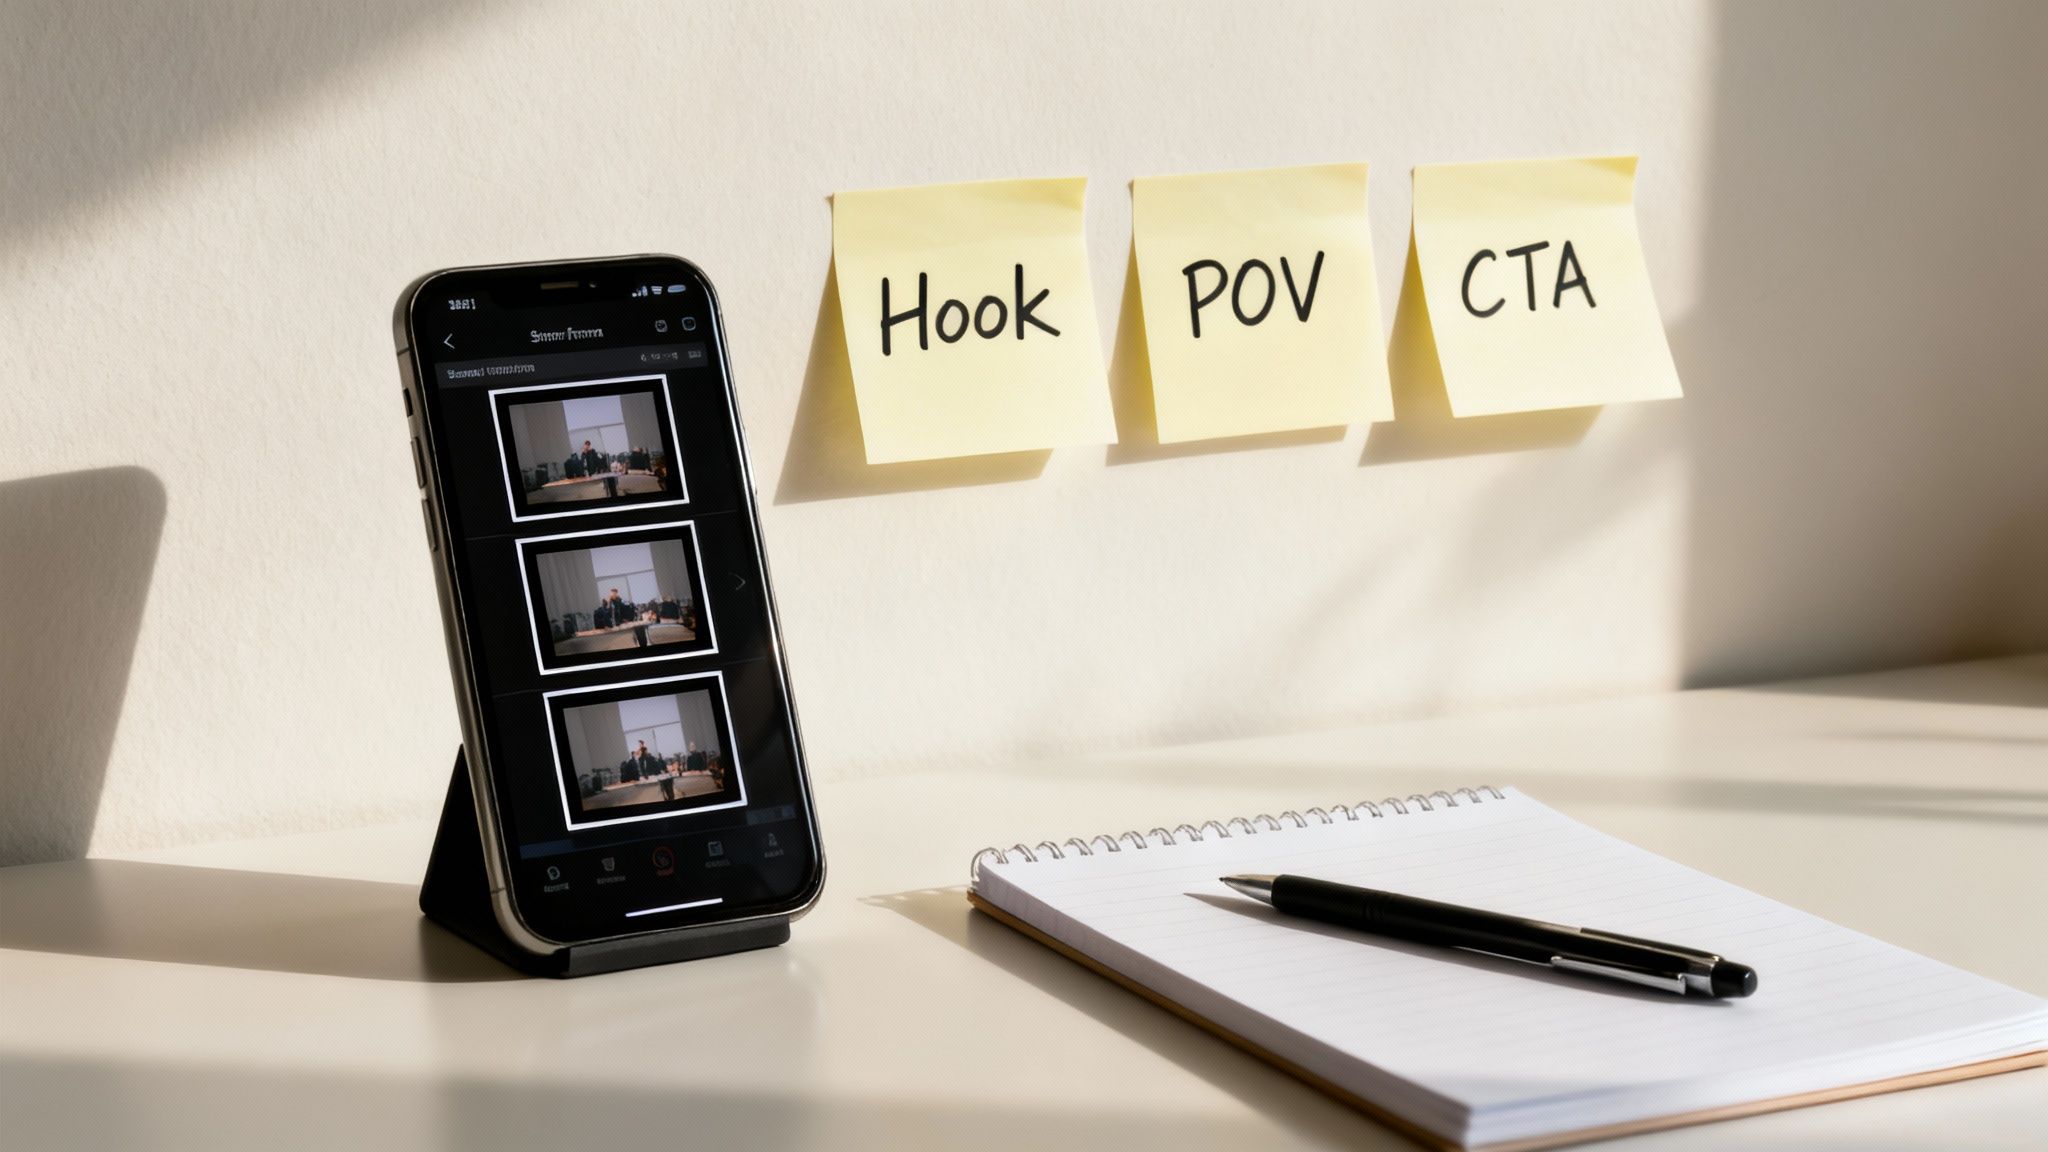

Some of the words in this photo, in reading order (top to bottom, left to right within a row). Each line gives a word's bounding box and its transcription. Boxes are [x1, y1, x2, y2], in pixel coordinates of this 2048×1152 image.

[880, 263, 1061, 357] Hook
[1182, 250, 1325, 339] POV
[1460, 240, 1597, 318] CTA
